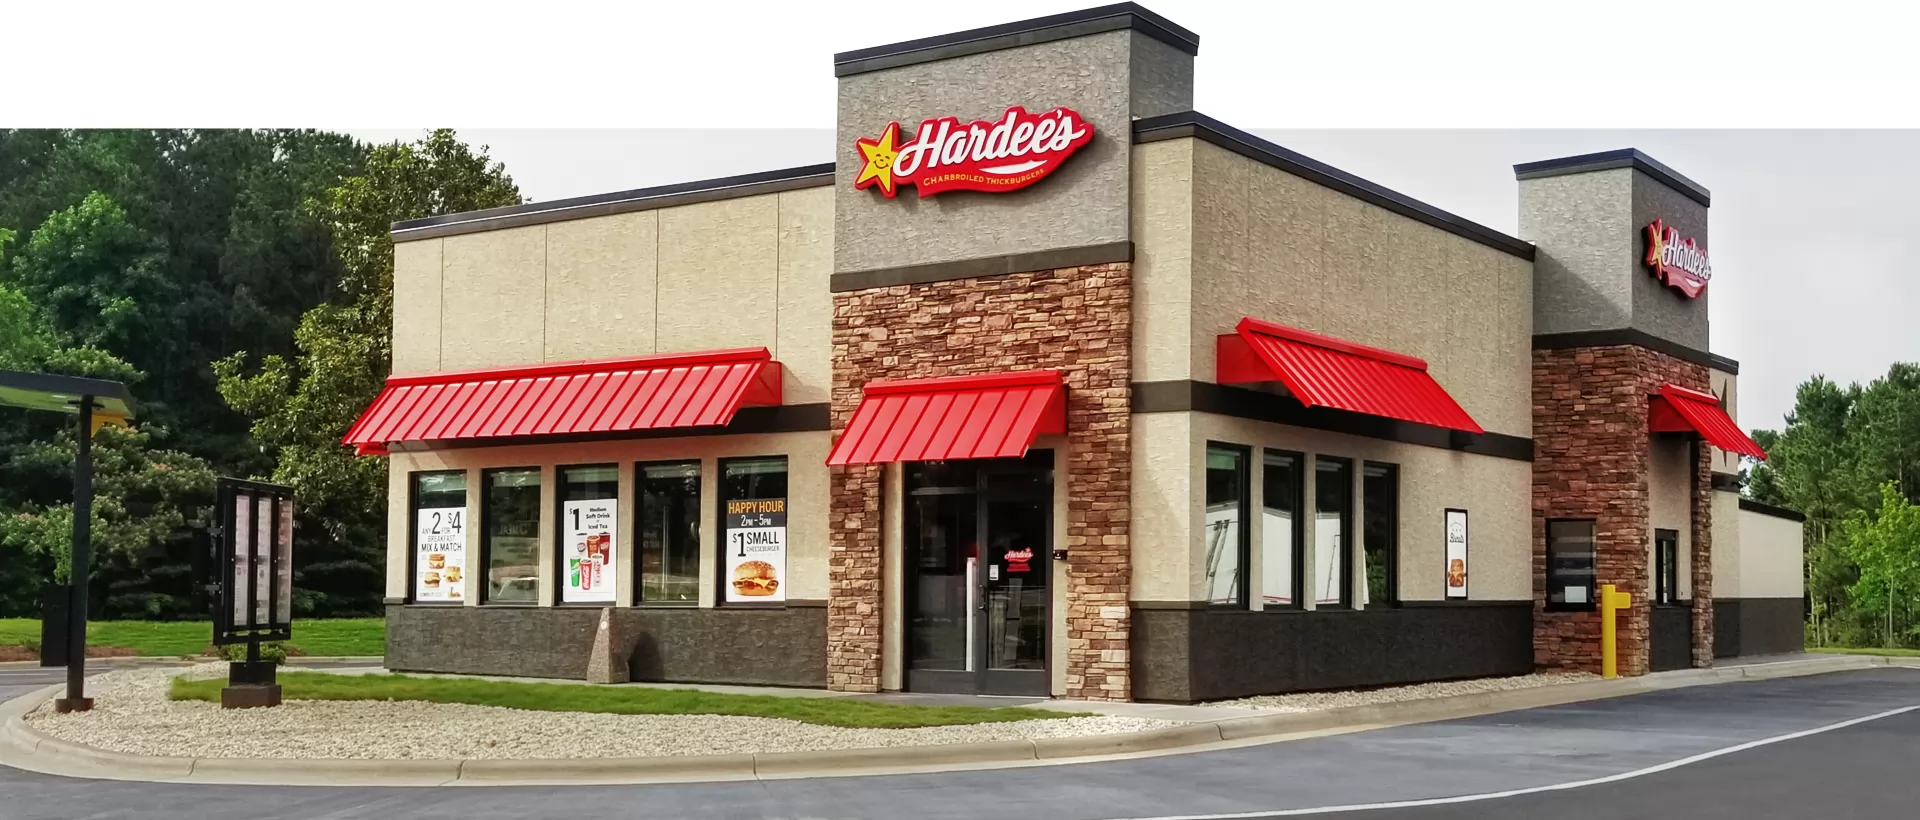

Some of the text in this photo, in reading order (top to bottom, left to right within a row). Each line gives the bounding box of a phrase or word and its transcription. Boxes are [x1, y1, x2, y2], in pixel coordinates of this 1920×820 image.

[892, 109, 1086, 176] Hardee's
[923, 168, 1045, 186] CHARBROILED THICKBURGERS
[1662, 231, 1712, 280] Hardee's
[728, 500, 784, 514] HAPPY HOUR
[421, 527, 431, 535] ANY
[431, 511, 441, 534] 2
[421, 542, 462, 552] MIX & MATCH
[746, 531, 779, 545] SMALL
